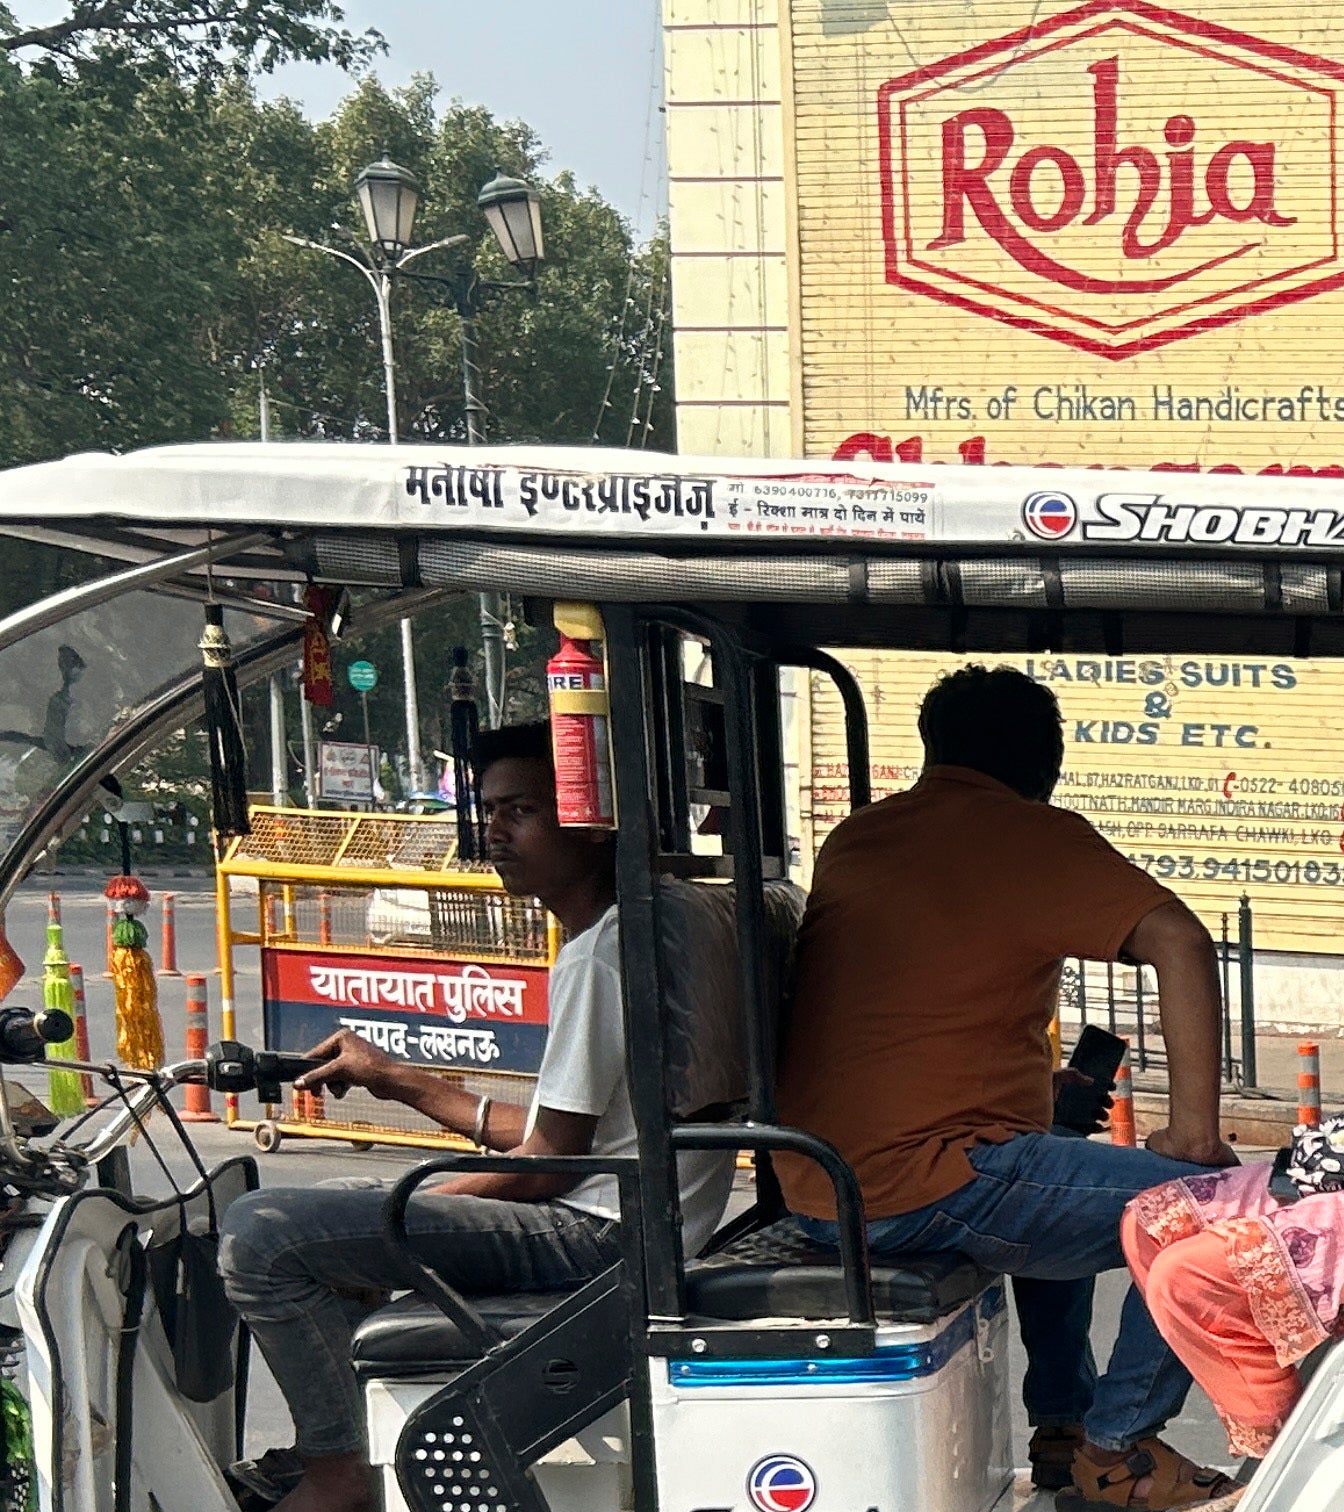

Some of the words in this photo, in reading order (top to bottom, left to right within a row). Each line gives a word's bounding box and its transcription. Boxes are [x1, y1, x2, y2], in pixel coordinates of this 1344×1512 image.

[906, 387, 976, 421] Mfrs.
[987, 386, 1018, 420] of
[1034, 386, 1137, 421] Chikan
[1026, 658, 1166, 686] LADIES
[1180, 660, 1298, 690] SUITS
[1143, 690, 1173, 720] &
[1073, 720, 1161, 745] KIDS
[1181, 723, 1272, 749] ETC.
[309, 965, 436, 1013] यातायात
[436, 965, 528, 1024] पुलिस
